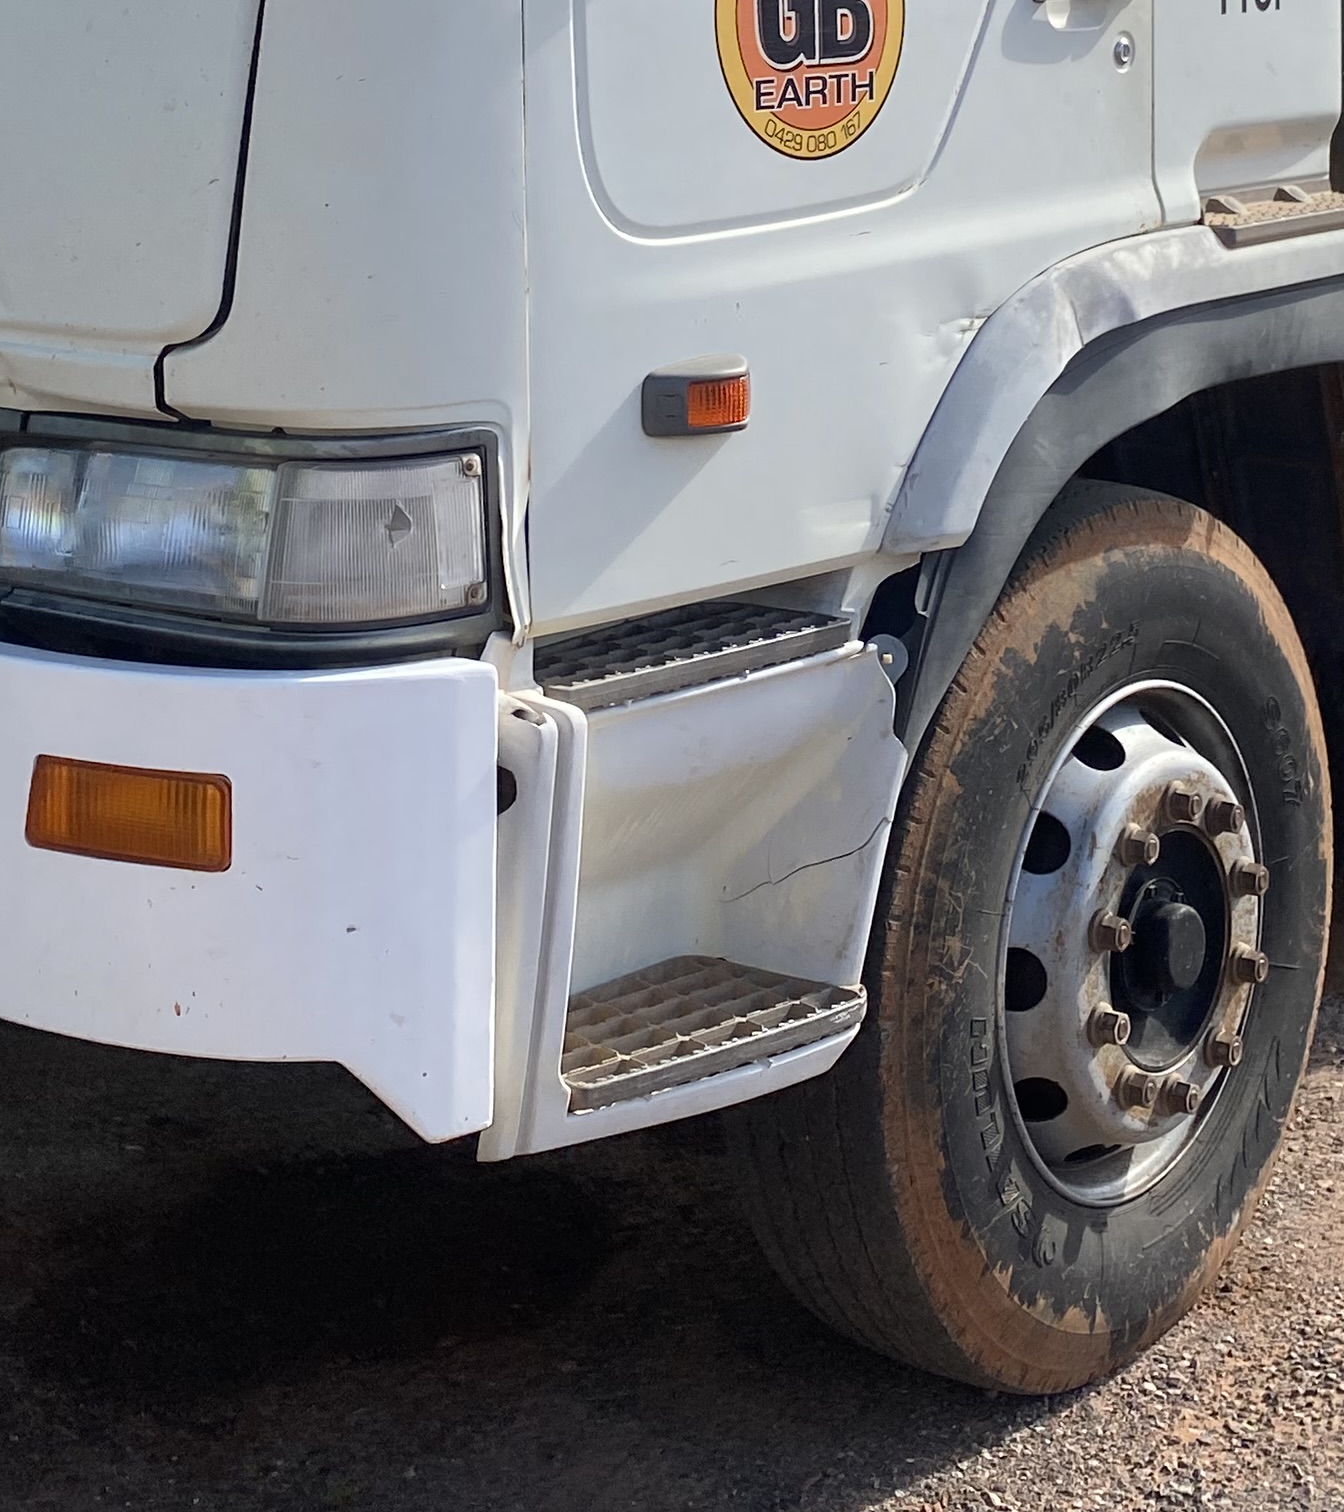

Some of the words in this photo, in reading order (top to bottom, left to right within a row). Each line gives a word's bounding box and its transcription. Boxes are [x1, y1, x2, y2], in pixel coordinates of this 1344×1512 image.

[754, 70, 875, 112] EARTH
[764, 118, 803, 152] 0429
[806, 130, 837, 153] 080
[840, 110, 861, 140] 167
